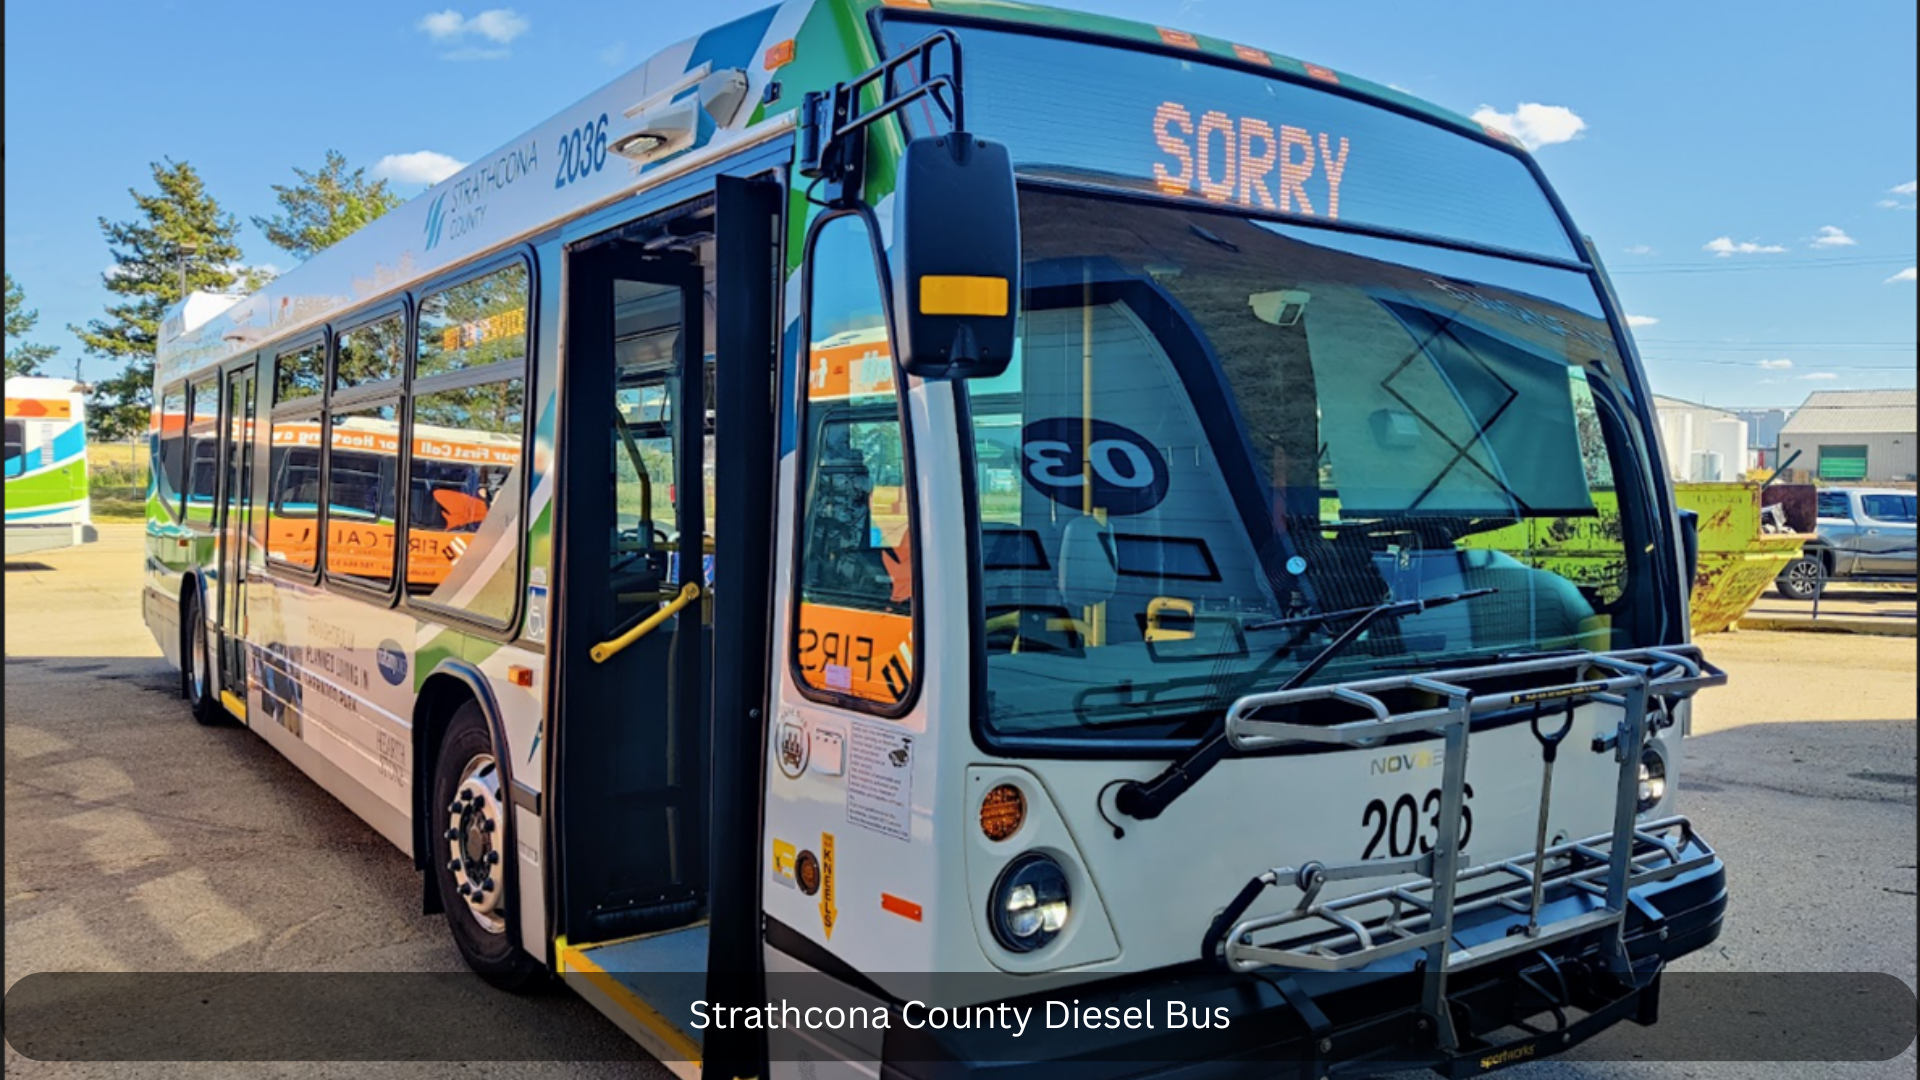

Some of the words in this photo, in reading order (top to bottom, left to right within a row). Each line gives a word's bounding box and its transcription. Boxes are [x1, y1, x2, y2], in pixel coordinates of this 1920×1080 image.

[451, 140, 537, 212] STRATHCONA
[555, 113, 608, 189] 2036
[1153, 101, 1349, 220] SORRY
[450, 203, 487, 240] COUNTY
[823, 848, 832, 928] KNEELS
